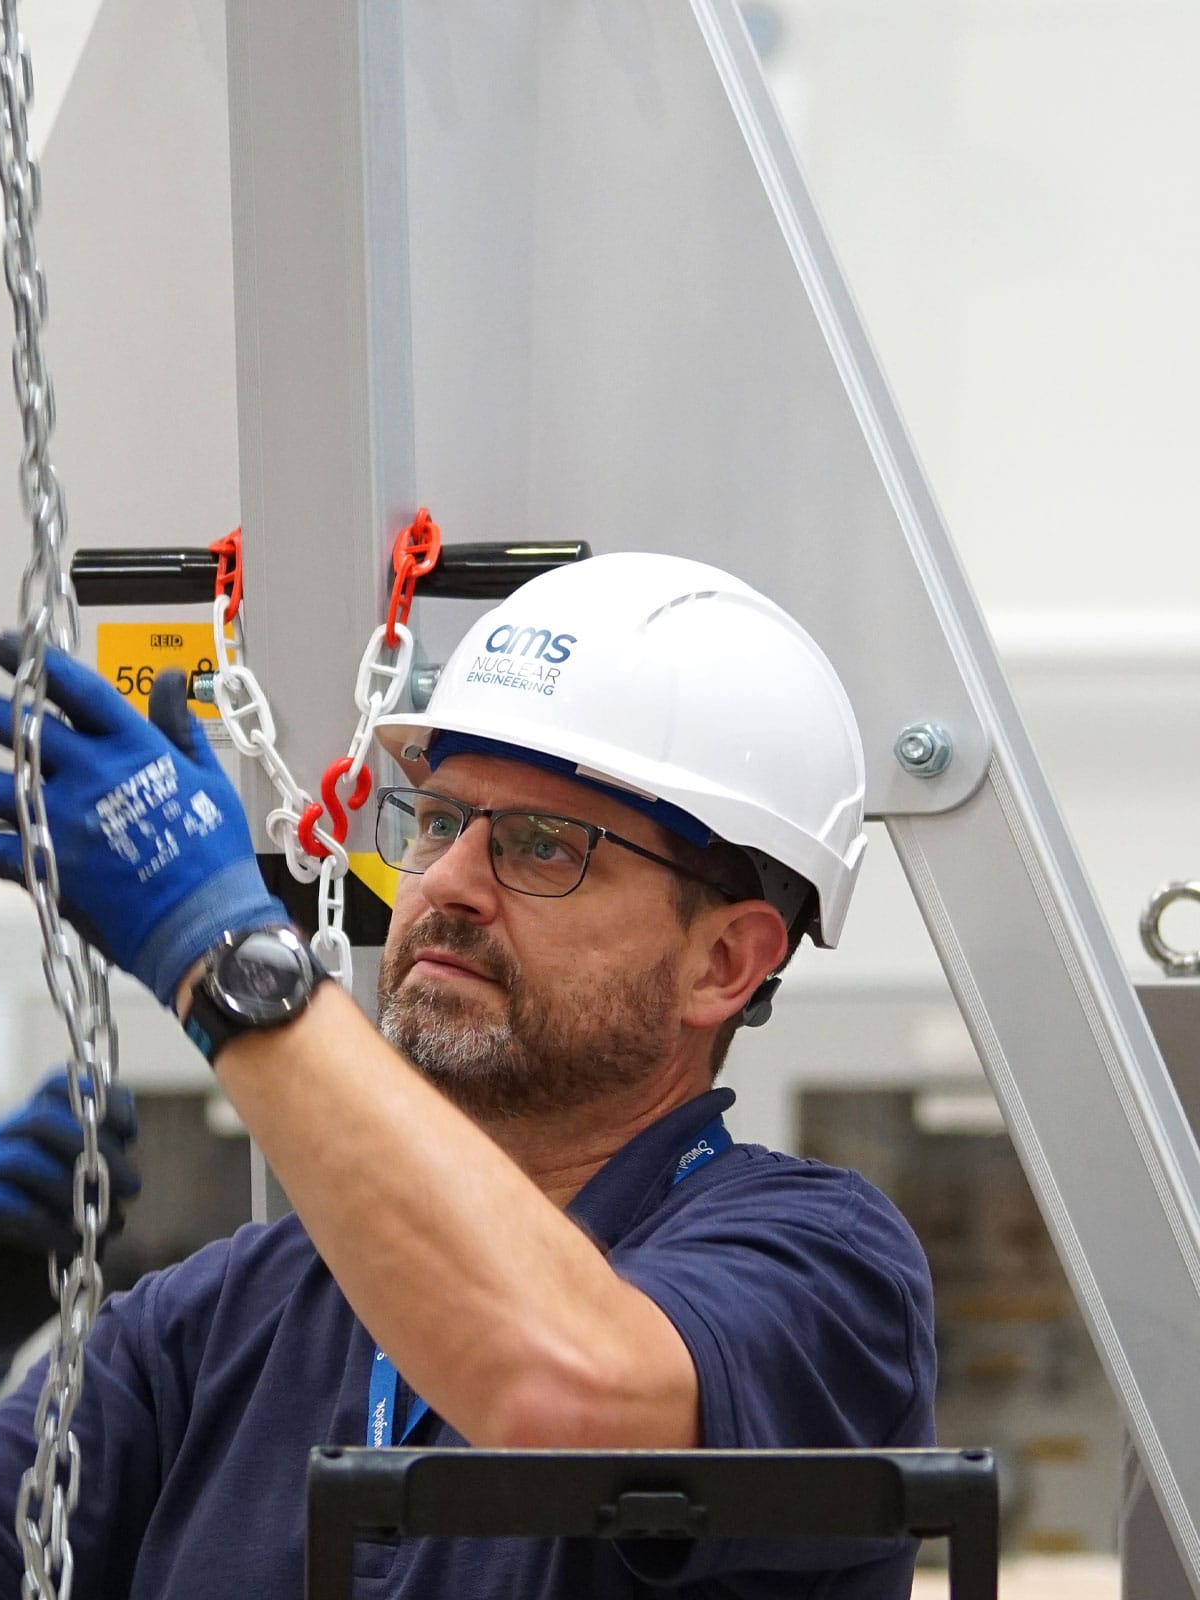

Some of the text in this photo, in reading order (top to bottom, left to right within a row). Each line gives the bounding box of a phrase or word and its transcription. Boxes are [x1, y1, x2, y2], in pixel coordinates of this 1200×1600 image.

[150, 634, 184, 647] REID
[485, 624, 578, 664] ams
[466, 671, 555, 696] ENGINEERING
[471, 656, 561, 685] NUCLEAR
[371, 1396, 388, 1450] wagelok
